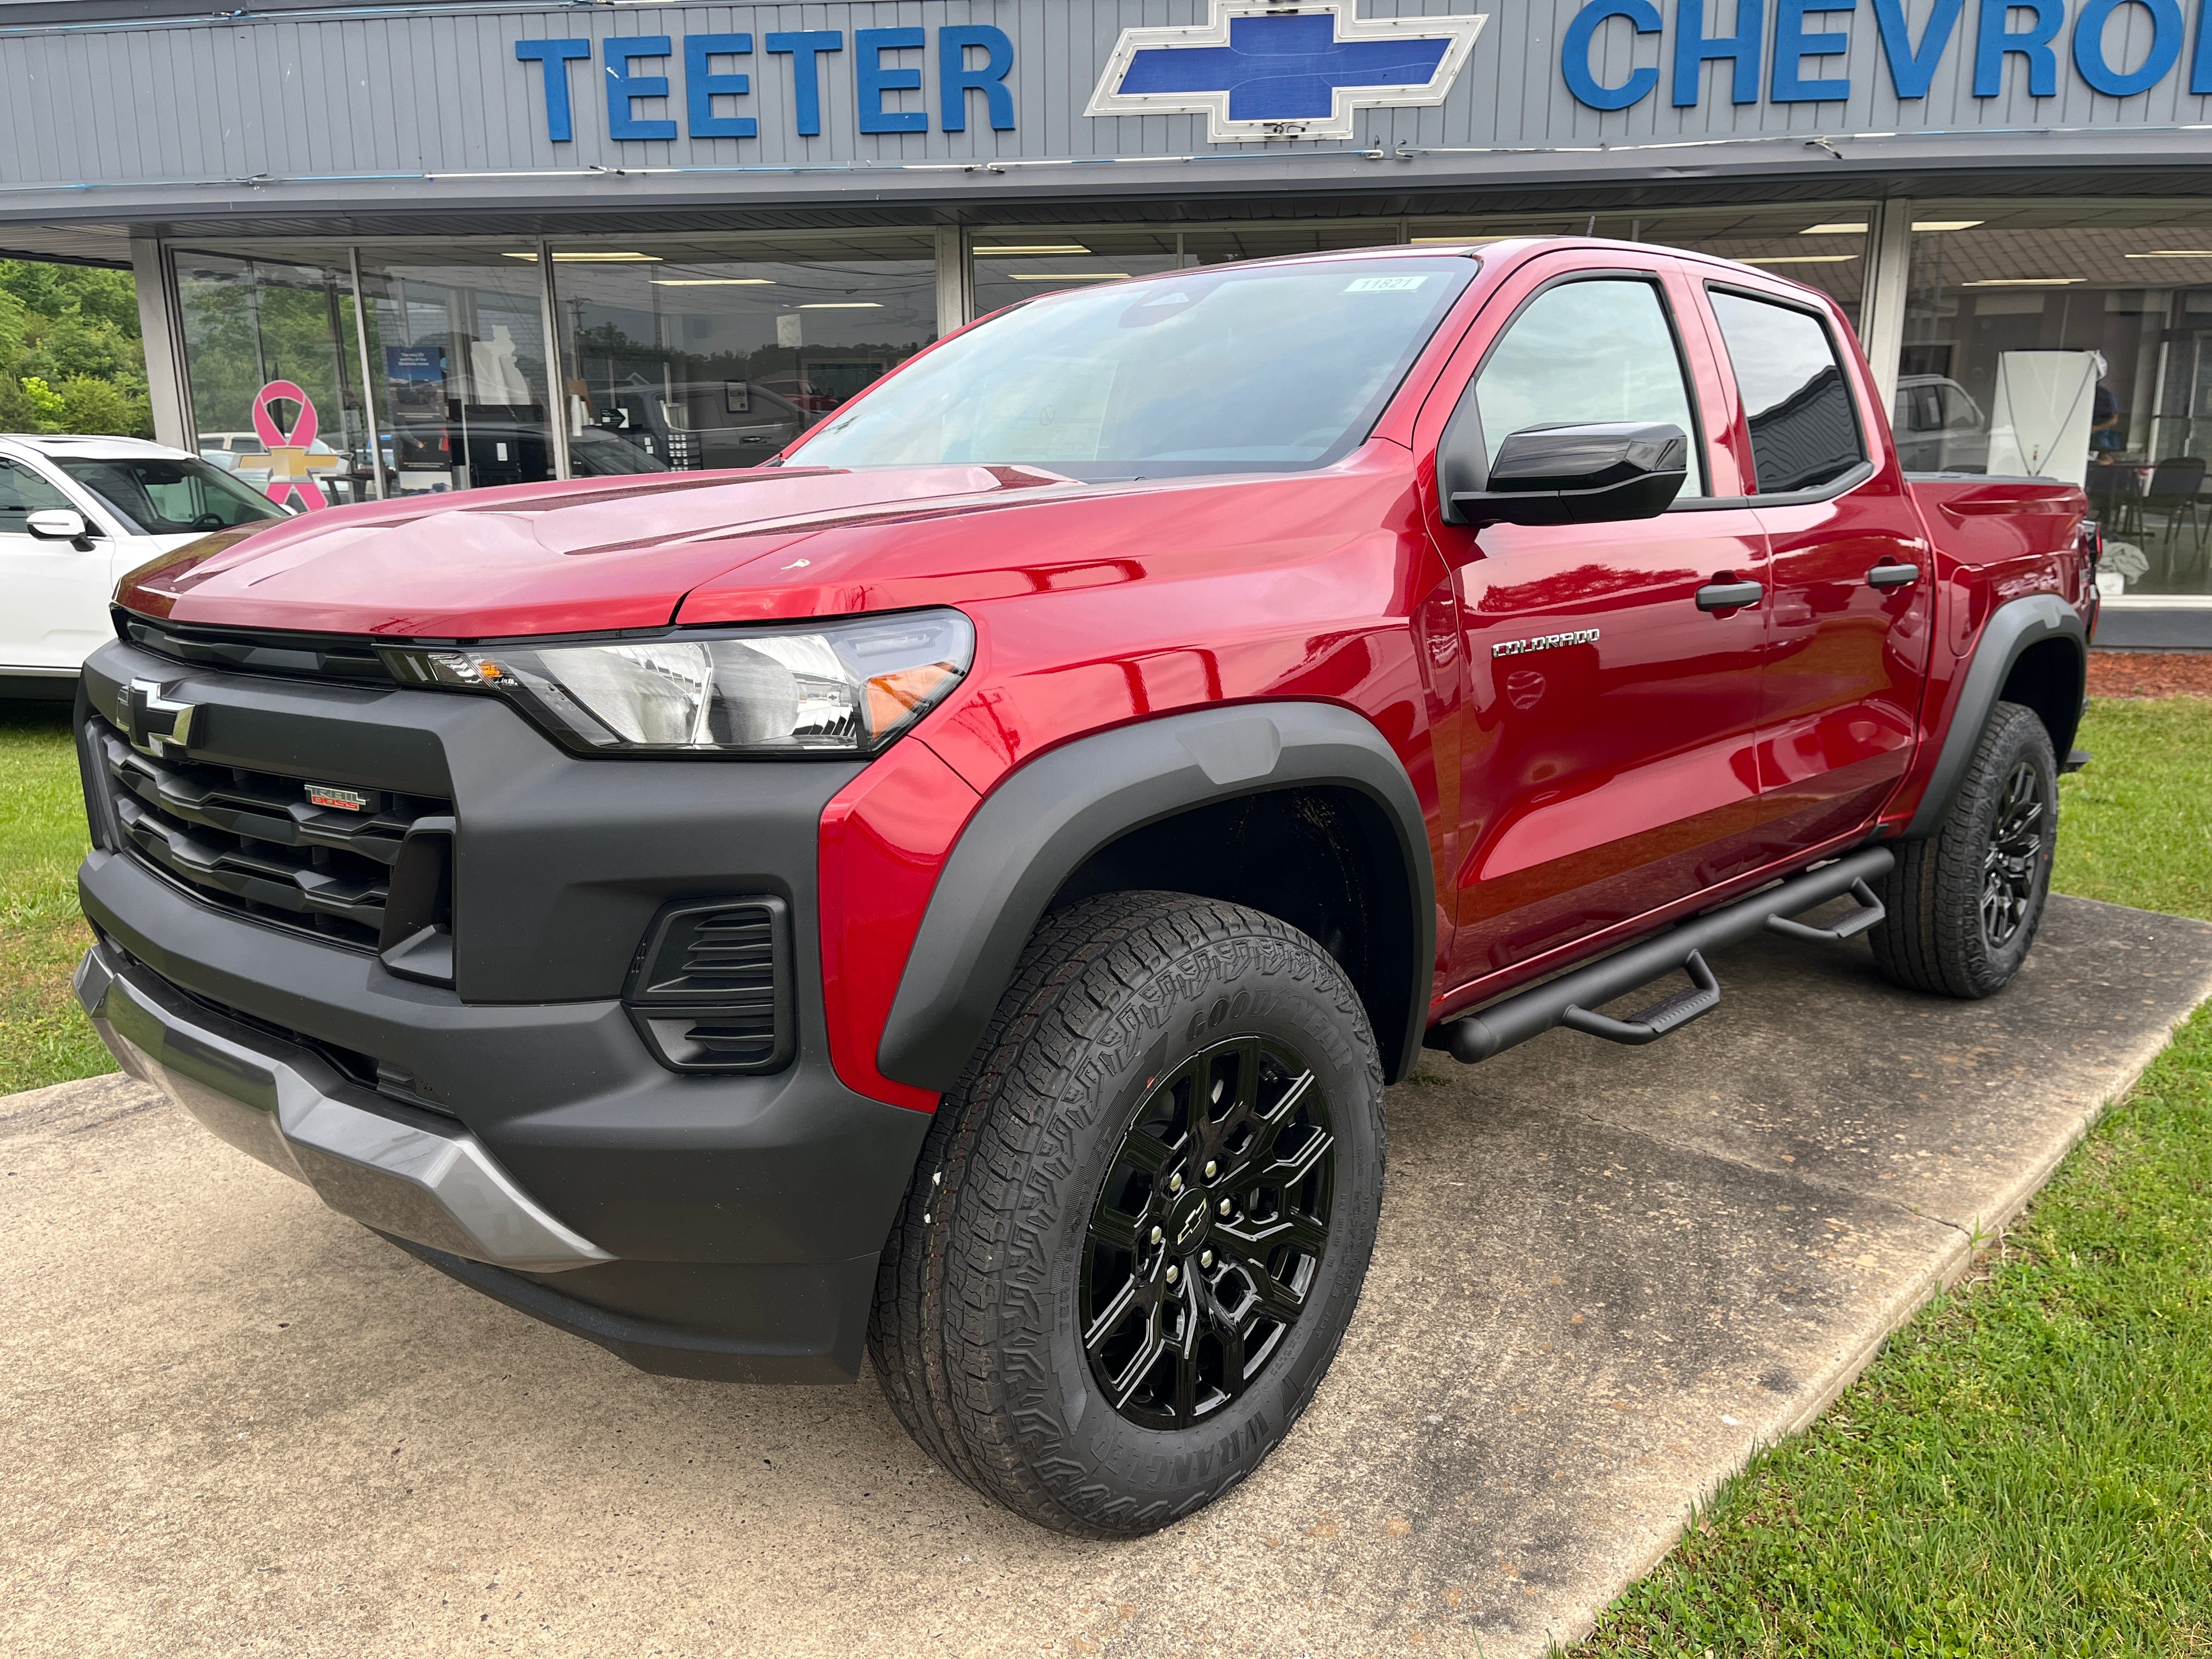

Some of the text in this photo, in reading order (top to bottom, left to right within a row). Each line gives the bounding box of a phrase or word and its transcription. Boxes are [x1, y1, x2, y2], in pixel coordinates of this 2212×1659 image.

[515, 0, 2212, 142] TEETER CHEVRO
[1360, 278, 1414, 290] 11821
[1492, 628, 1600, 658] COLORADO
[304, 784, 366, 805] TRAIL
[312, 795, 359, 811] BOSS
[1186, 987, 1353, 1072] GOODYEAR
[1090, 1410, 1270, 1488] WRANGLER
